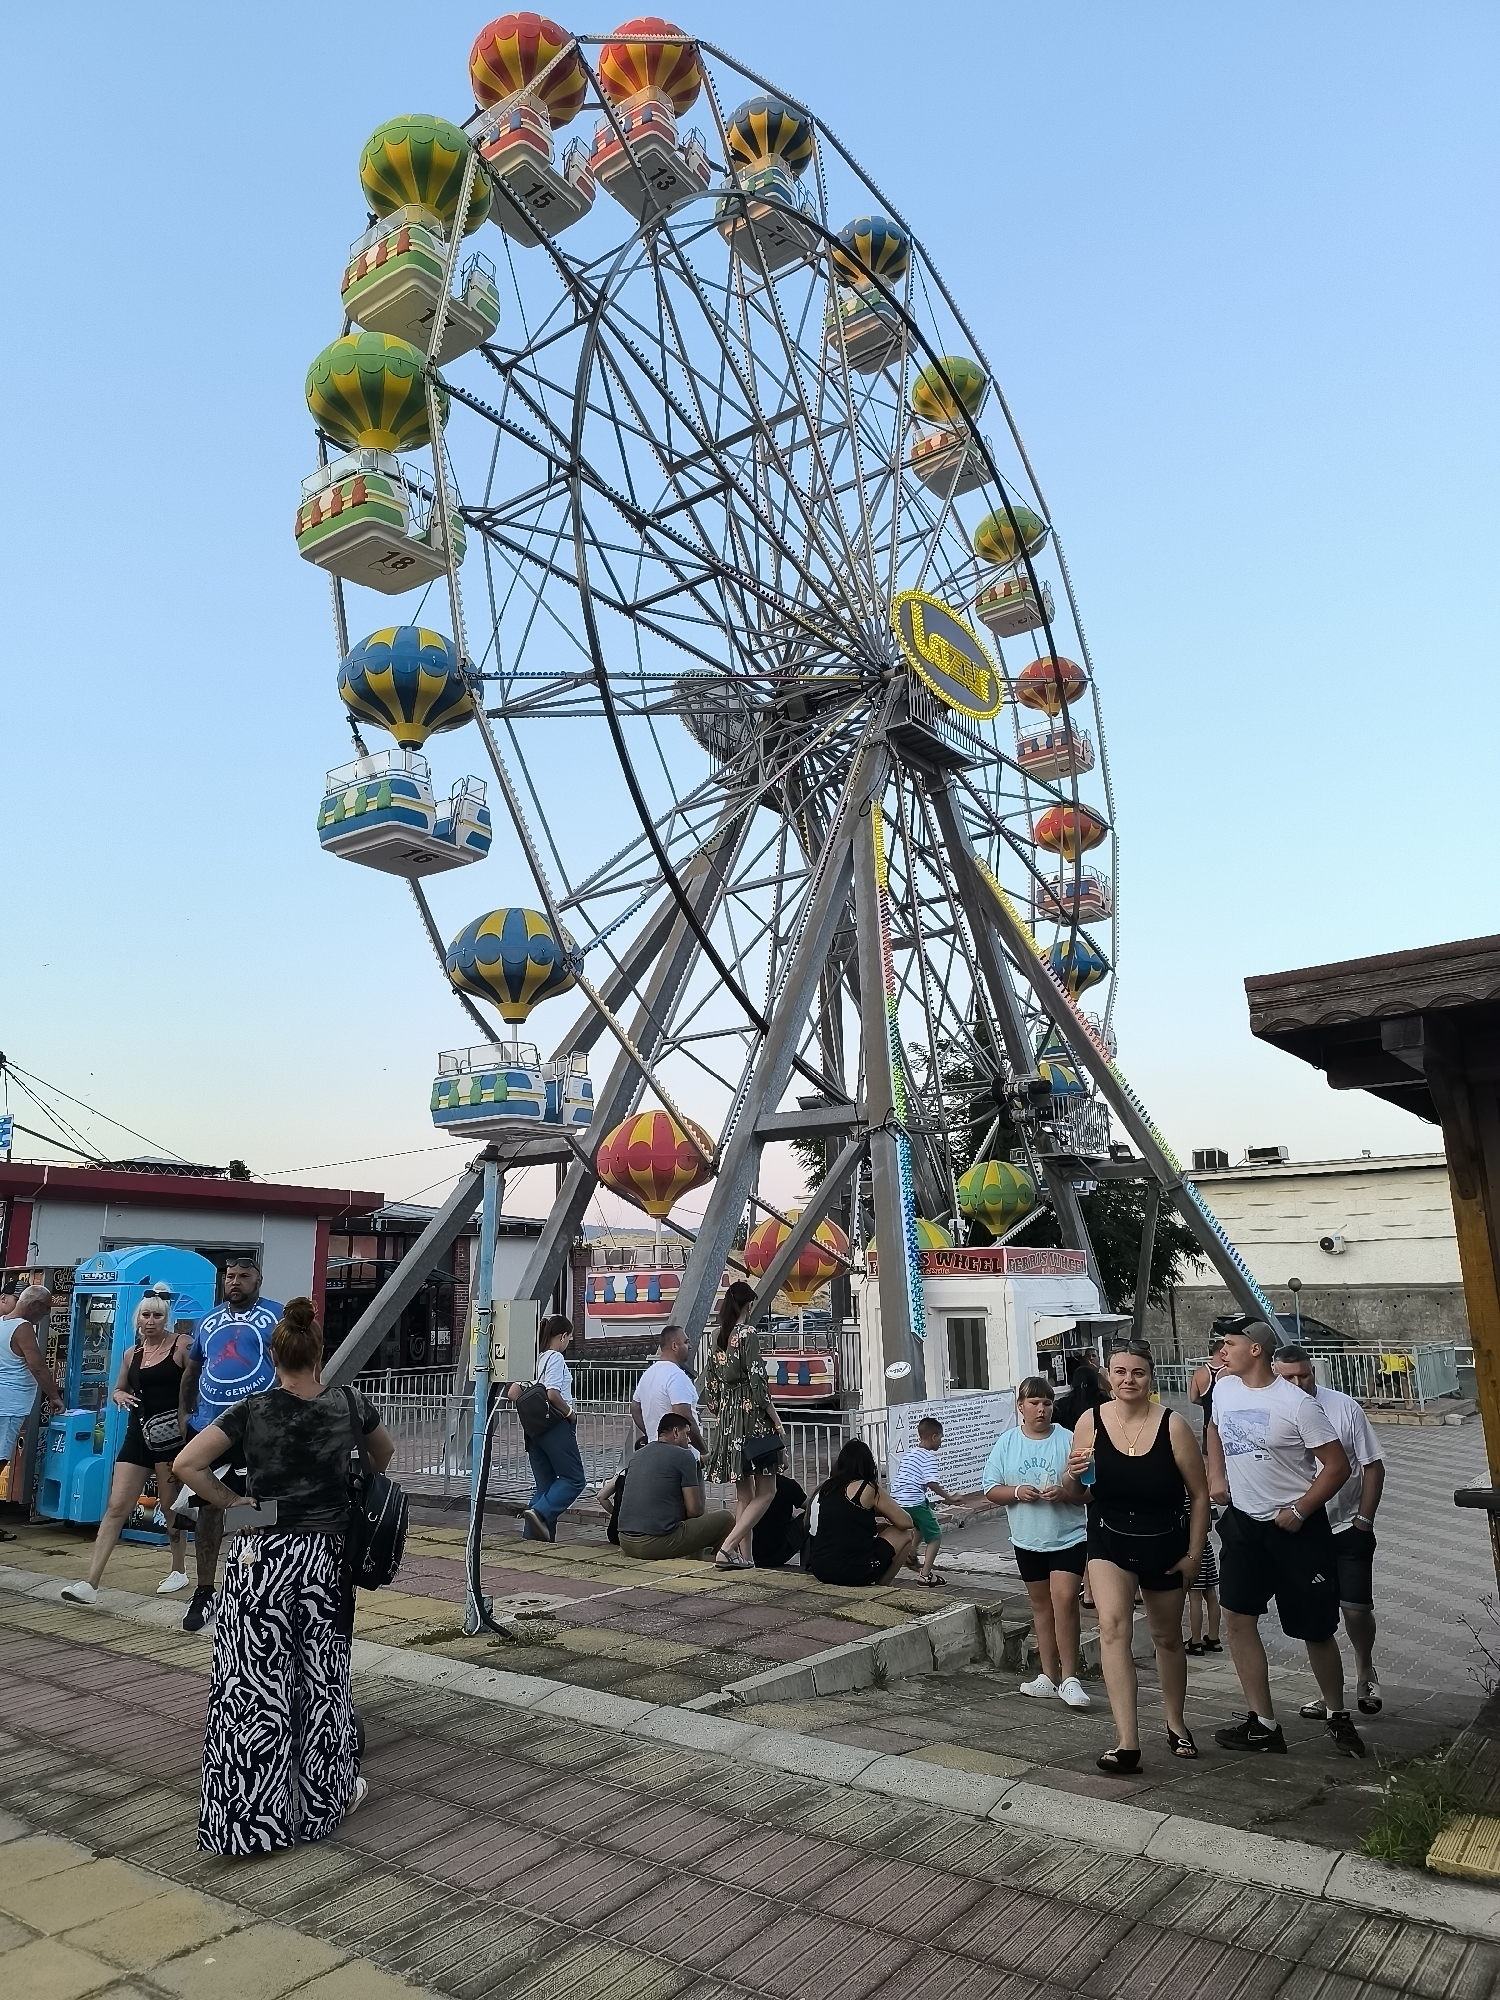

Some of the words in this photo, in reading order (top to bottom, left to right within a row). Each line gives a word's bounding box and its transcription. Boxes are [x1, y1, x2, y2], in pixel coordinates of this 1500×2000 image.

[649, 167, 677, 191] 13
[523, 182, 556, 208] 15
[379, 551, 416, 569] 18
[400, 849, 440, 863] 16
[935, 1251, 1002, 1273] WHEEL
[1007, 1252, 1047, 1273] FERRIS
[1049, 1252, 1086, 1274] WHEEL
[203, 1311, 272, 1333] PARIS
[201, 1377, 217, 1395] SAINT
[225, 1375, 266, 1397] GERMAIN
